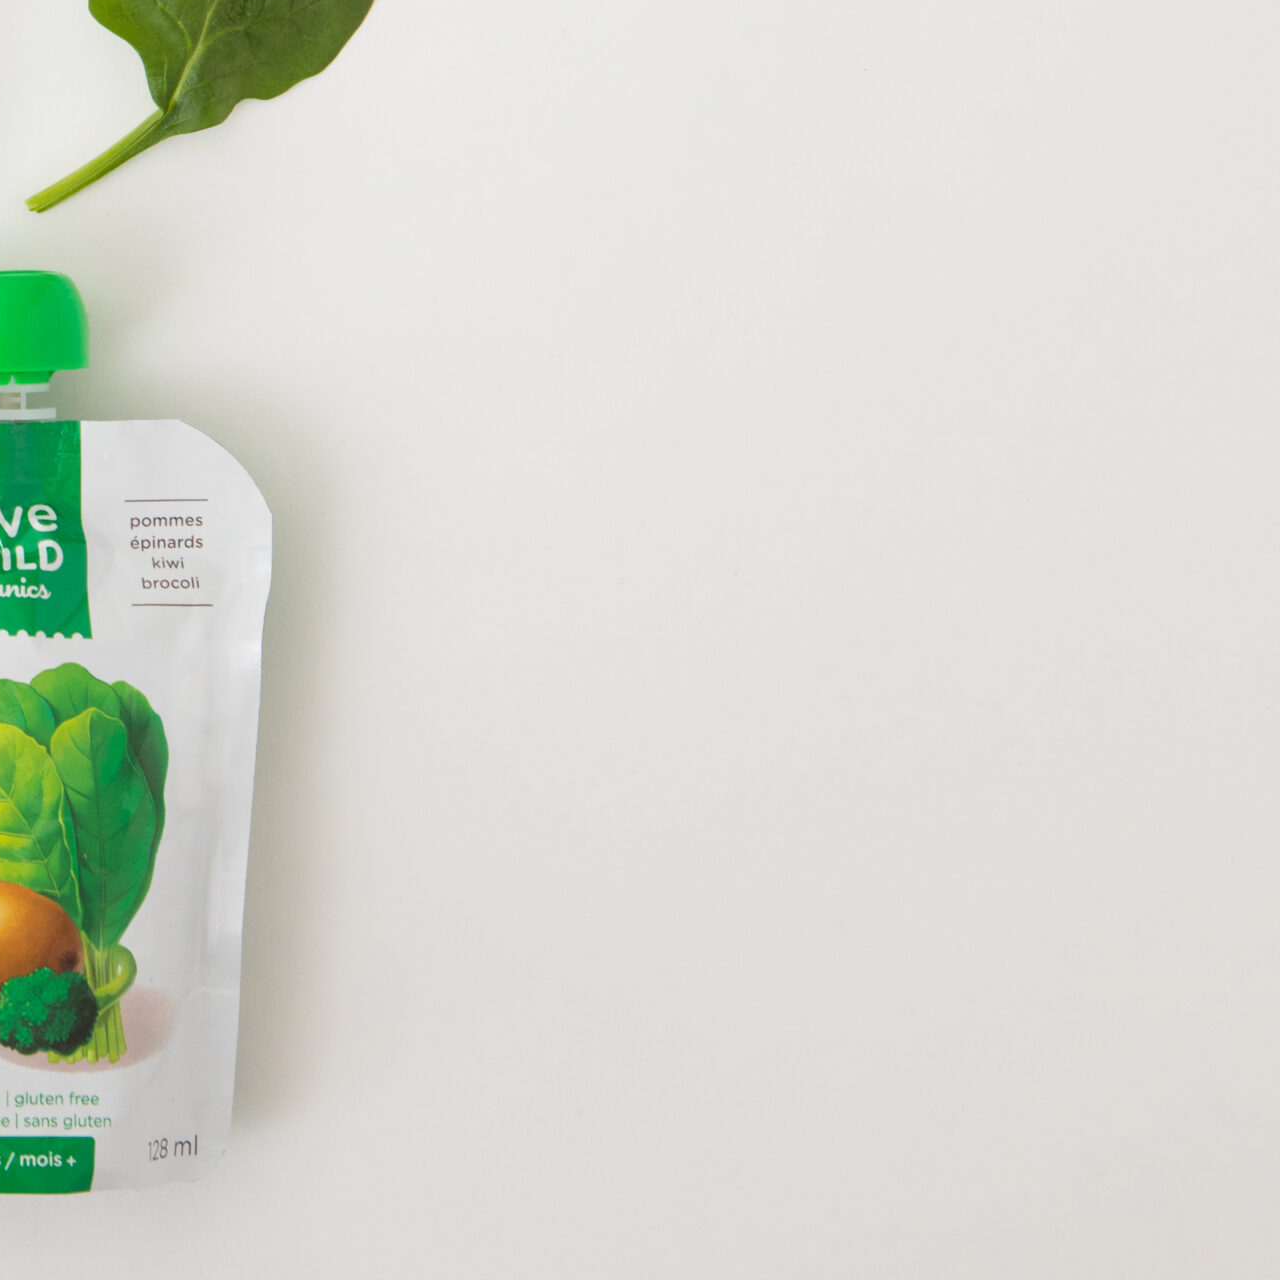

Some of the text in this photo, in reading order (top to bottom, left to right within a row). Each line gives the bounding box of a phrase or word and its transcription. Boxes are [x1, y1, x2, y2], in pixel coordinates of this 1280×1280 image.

[130, 515, 204, 530] pommes
[130, 535, 204, 552] épinards
[151, 557, 185, 570] kiwi
[141, 576, 201, 590] brocoli
[14, 1091, 64, 1108] gluten
[69, 1091, 100, 1105] free
[23, 1117, 58, 1128] sans
[62, 1114, 112, 1130] gluten
[147, 1133, 198, 1162] 128 ml
[19, 1151, 63, 1167] mois
